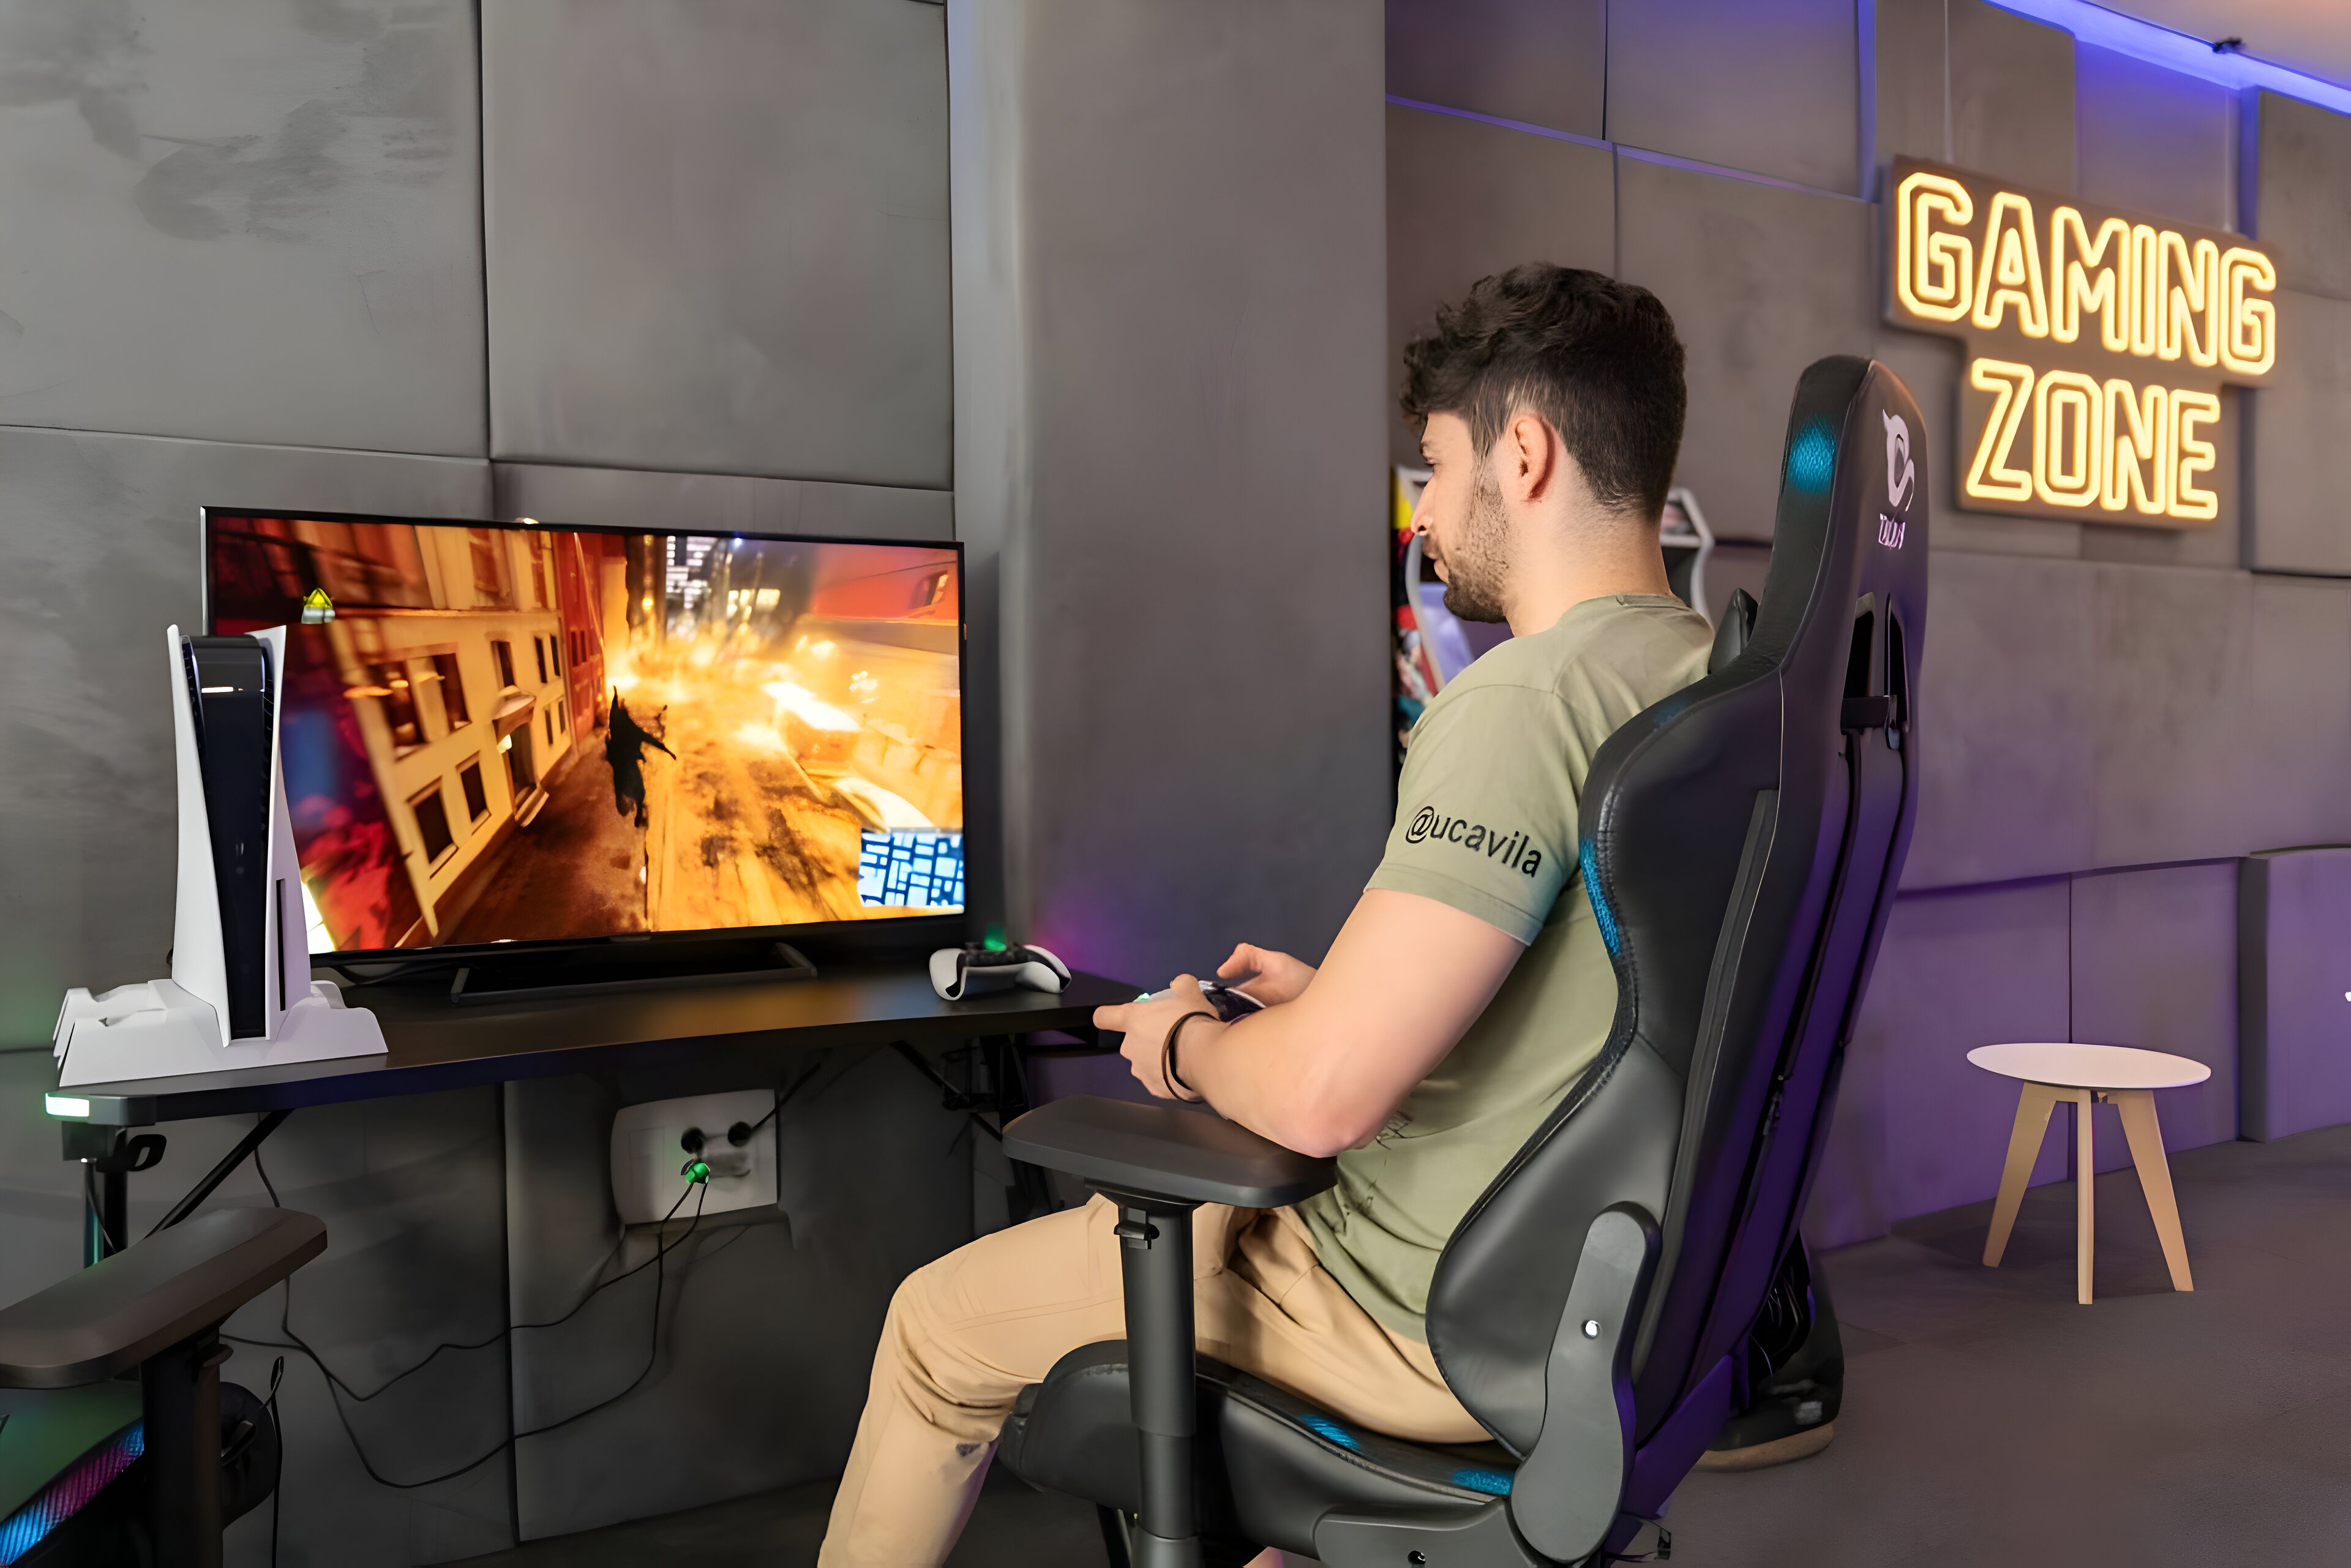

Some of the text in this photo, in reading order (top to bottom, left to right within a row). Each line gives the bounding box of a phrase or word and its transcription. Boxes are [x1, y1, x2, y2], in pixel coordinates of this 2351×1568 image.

[1897, 171, 2276, 376] GAMING
[1965, 358, 2221, 520] ZONE
[1405, 806, 1542, 878] @ucavila
